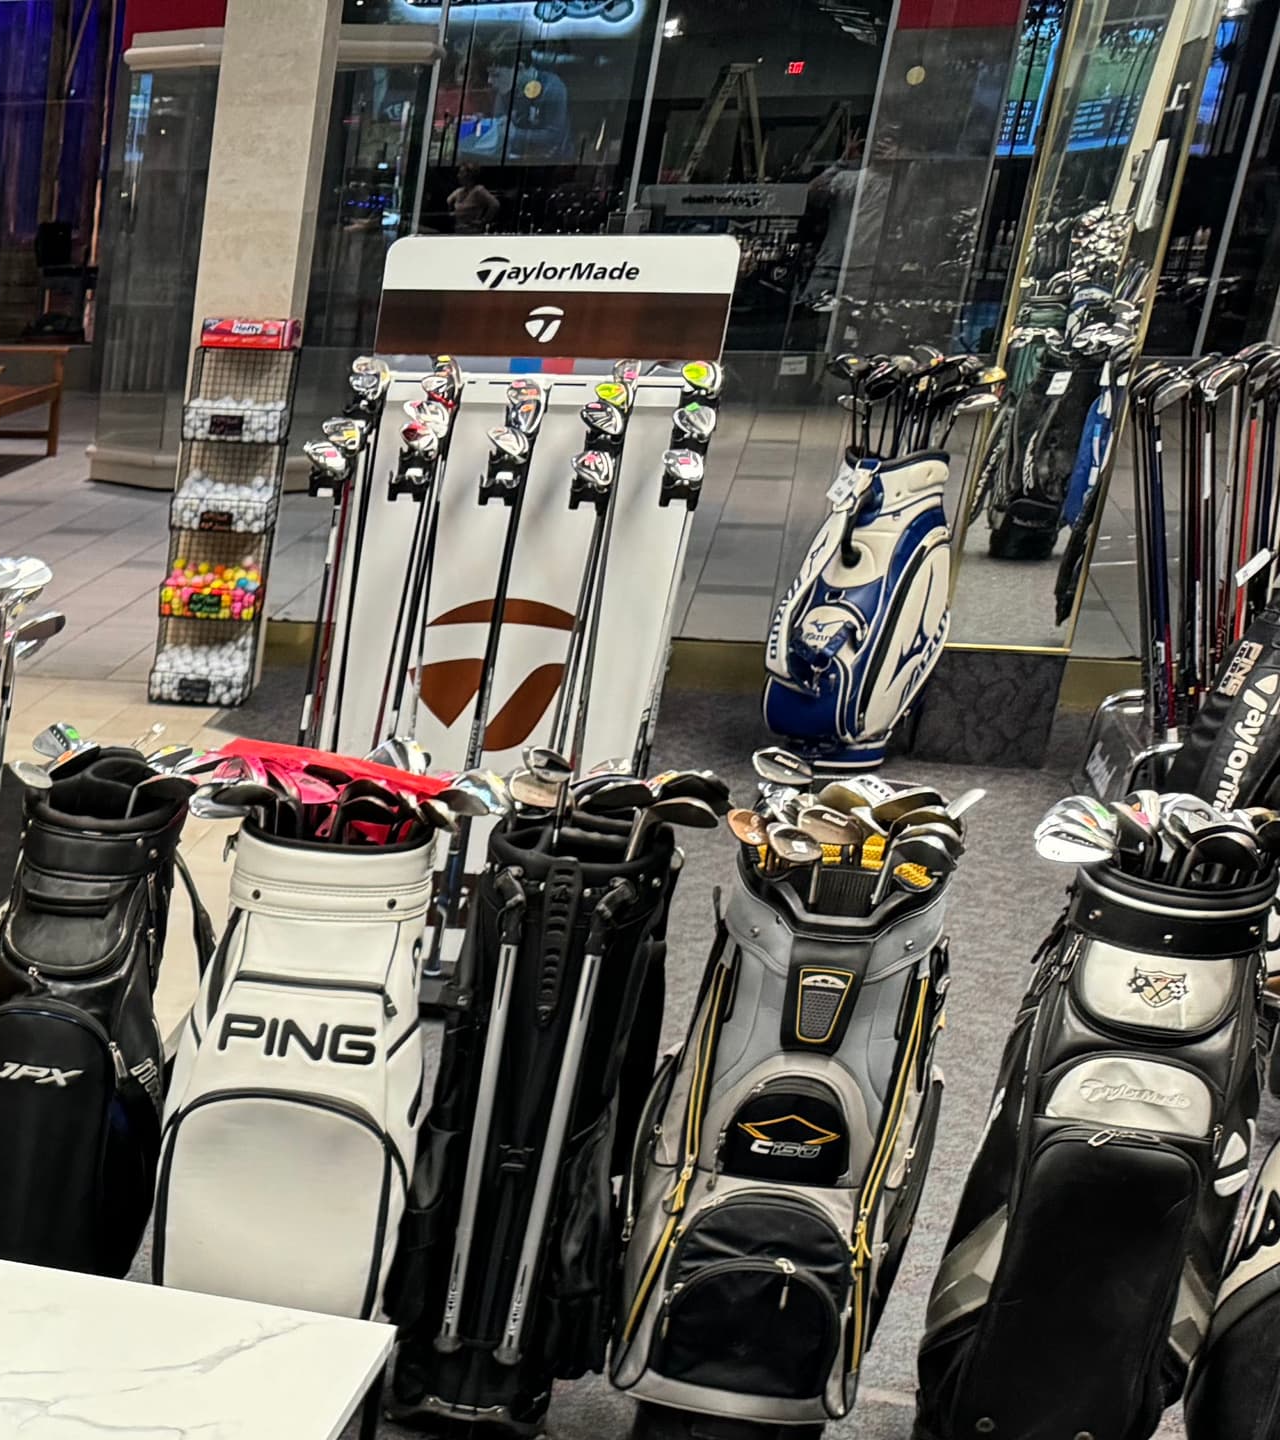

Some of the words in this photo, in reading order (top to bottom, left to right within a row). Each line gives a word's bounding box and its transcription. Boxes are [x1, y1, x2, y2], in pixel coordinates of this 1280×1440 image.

[476, 256, 640, 289] TaylorMade
[234, 323, 260, 334] Hefty
[1226, 641, 1264, 697] PING
[217, 1012, 377, 1066] PING
